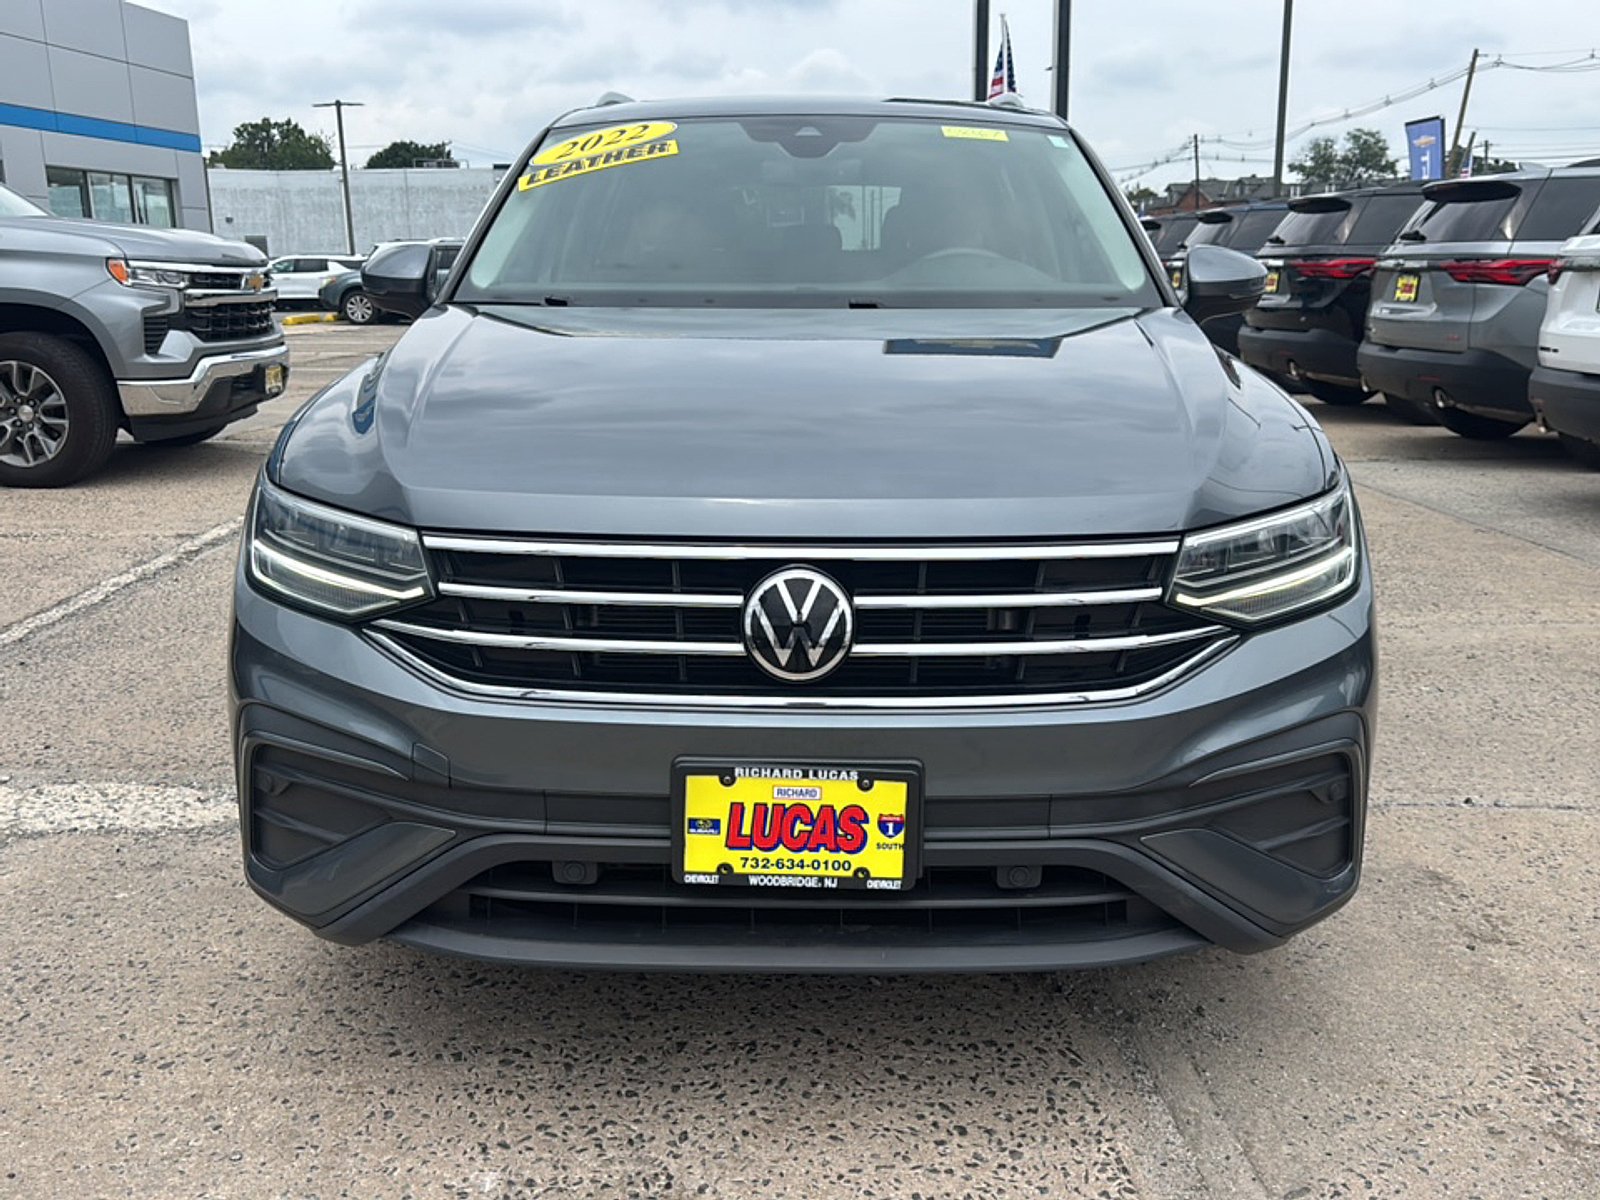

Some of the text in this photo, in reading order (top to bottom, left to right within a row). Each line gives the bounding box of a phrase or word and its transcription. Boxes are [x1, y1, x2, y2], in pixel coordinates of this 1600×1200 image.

[555, 124, 649, 157] 2022
[526, 142, 672, 186] LEATHER
[734, 767, 859, 781] RICHARD LUCAS
[776, 788, 818, 798] RICHARD
[725, 802, 869, 854] LUCAS
[876, 842, 904, 850] SOUTH
[740, 856, 852, 871] 732-634-0100
[823, 877, 838, 889] NJ
